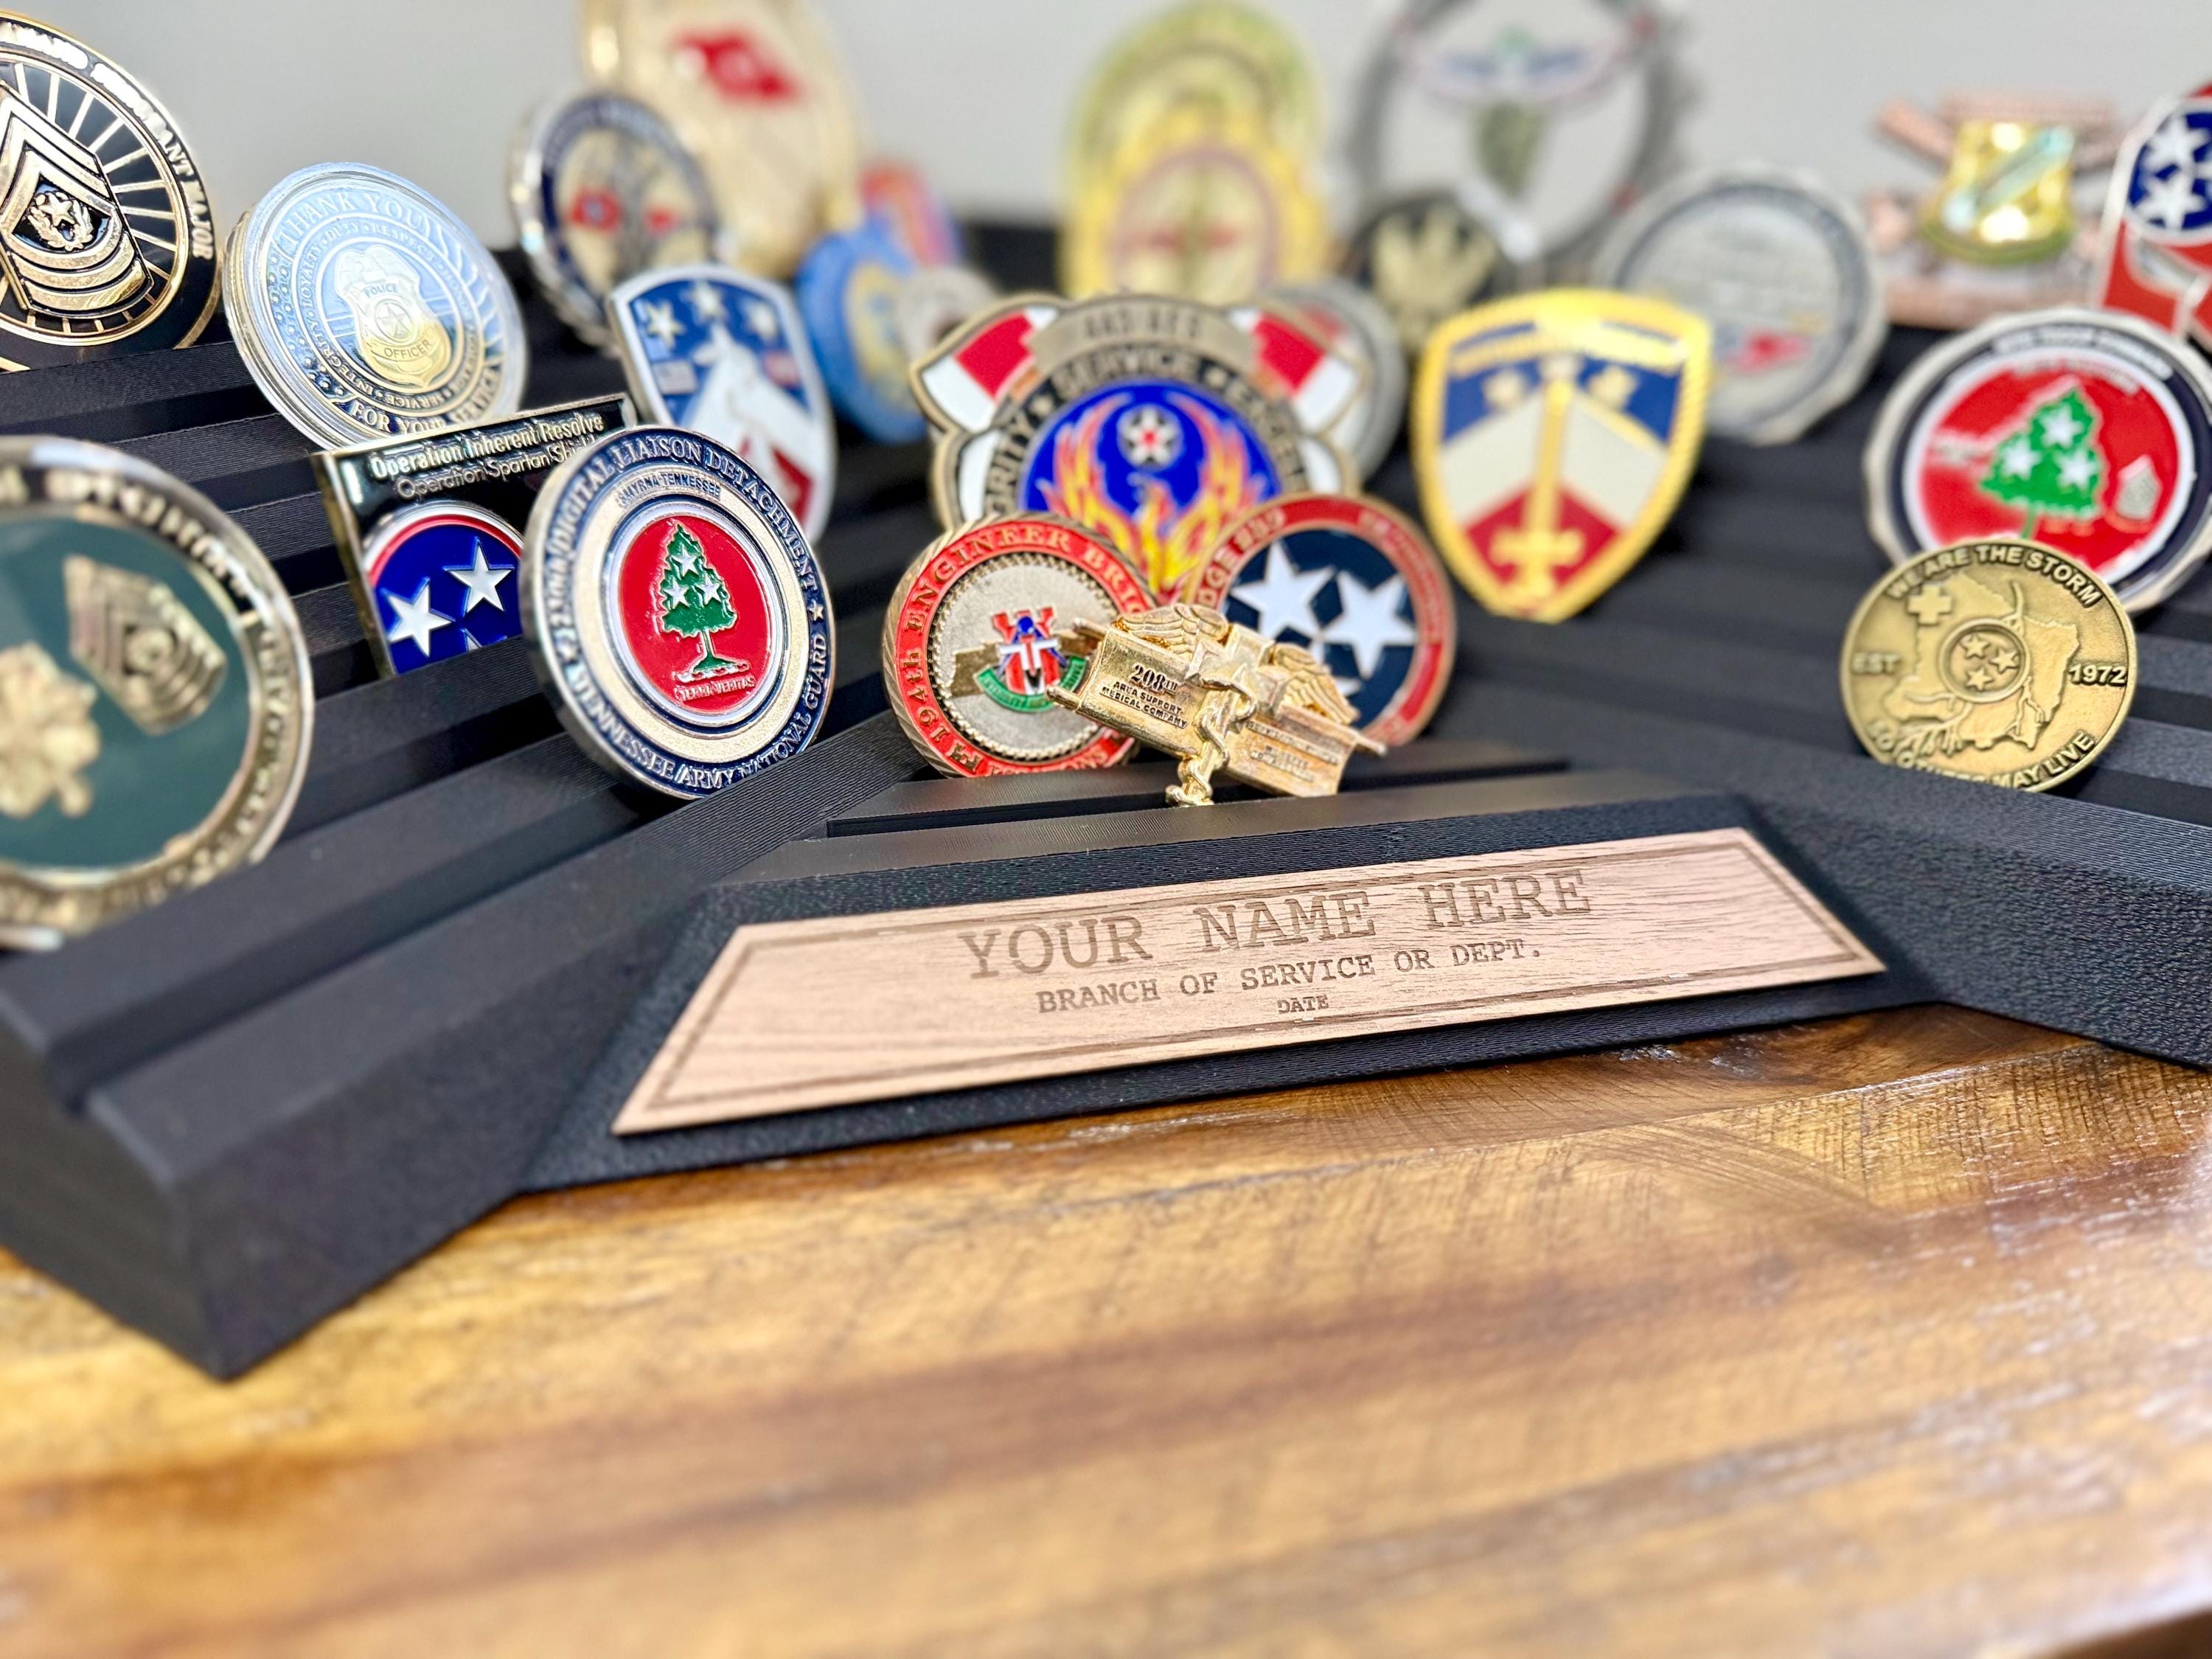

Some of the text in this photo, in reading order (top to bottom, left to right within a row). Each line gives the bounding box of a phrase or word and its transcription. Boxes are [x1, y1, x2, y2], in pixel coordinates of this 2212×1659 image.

[277, 192, 423, 246] THANK YOU
[364, 283, 398, 299] POLICE
[384, 340, 431, 358] OFFICER
[351, 401, 391, 434] FOR
[370, 414, 605, 479] Operation Inherent Resolve
[397, 467, 484, 502] Operation
[486, 452, 550, 482] Spartan
[547, 457, 616, 554] DIGITAL
[613, 434, 702, 470] LIAISON
[706, 442, 819, 593] DETACHMENT
[905, 526, 1071, 633] ENGINEER
[1922, 548, 1970, 579] ARE
[1975, 545, 2023, 566] THE
[2026, 552, 2103, 608] STORM
[804, 633, 827, 710] GUARD
[902, 652, 950, 742] 194th
[2067, 663, 2128, 686] 1972
[1102, 686, 1188, 728] MEDICAL COMPANY
[1140, 692, 1182, 716] SUPPORT
[2042, 728, 2097, 775] LIVE
[959, 869, 1592, 979] YOUR NAME HERE
[1035, 937, 1540, 1014] BRANCH OF SERVICE OR DEPT.
[1277, 993, 1329, 1015] DATE
